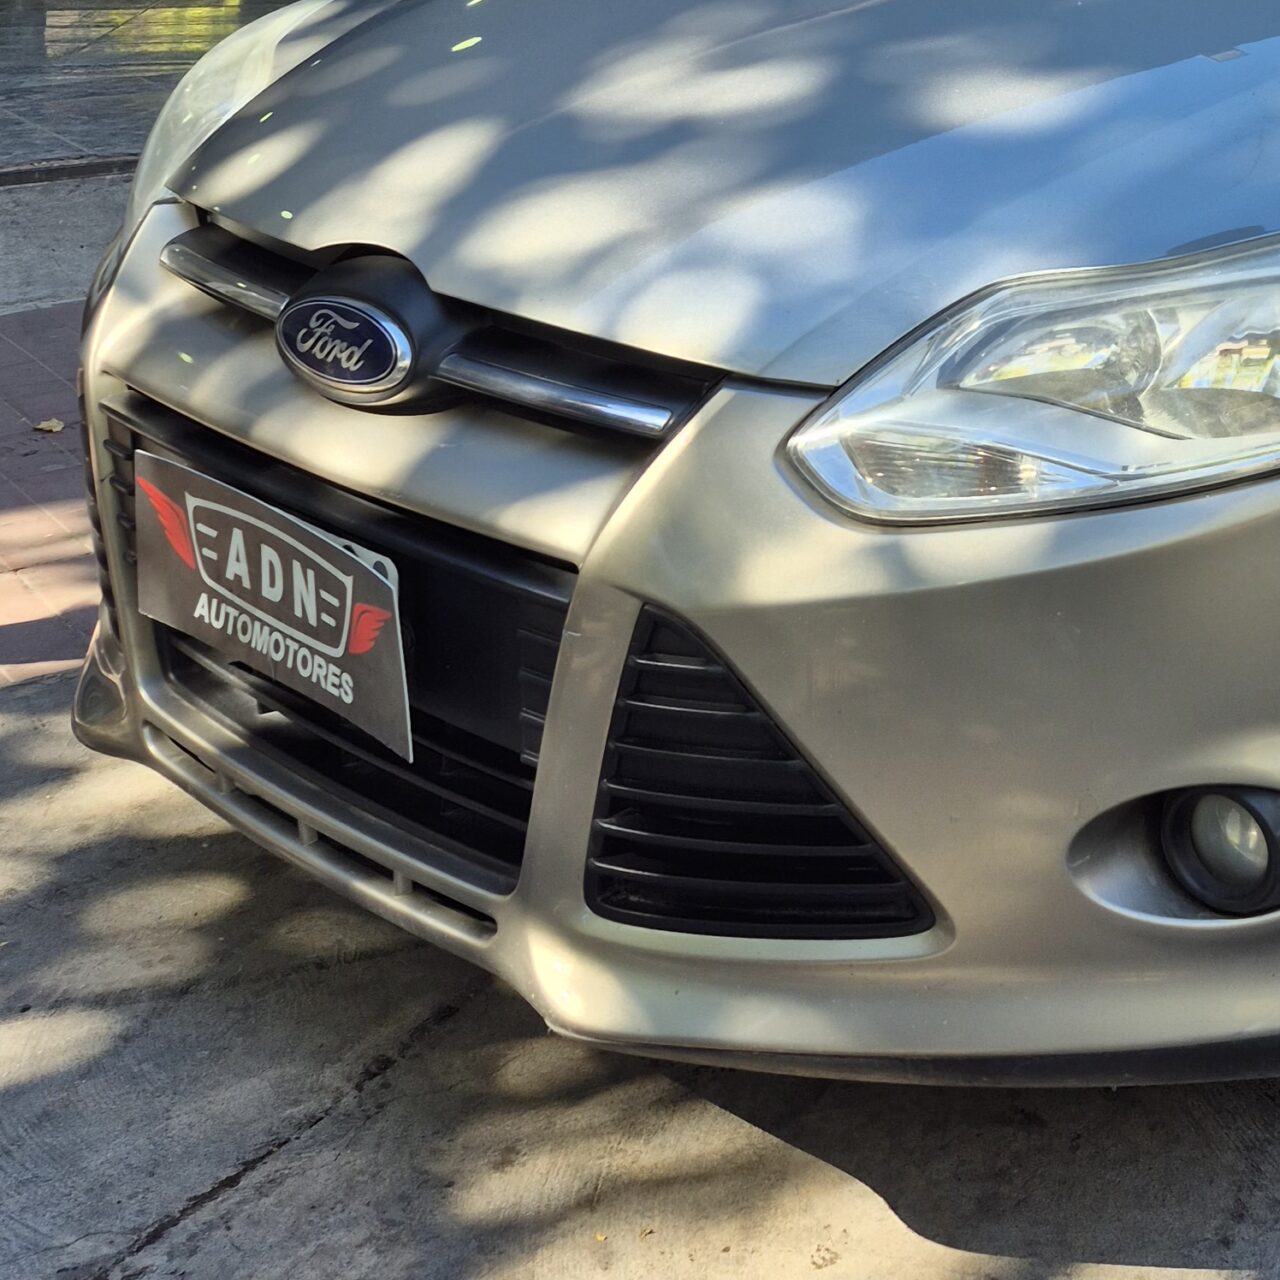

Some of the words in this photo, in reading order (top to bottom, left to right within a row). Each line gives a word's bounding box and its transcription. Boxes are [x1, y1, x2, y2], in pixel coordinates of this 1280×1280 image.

[296, 308, 374, 372] Ford
[225, 527, 318, 628] ADN
[193, 592, 354, 705] AUTOMOTORES
